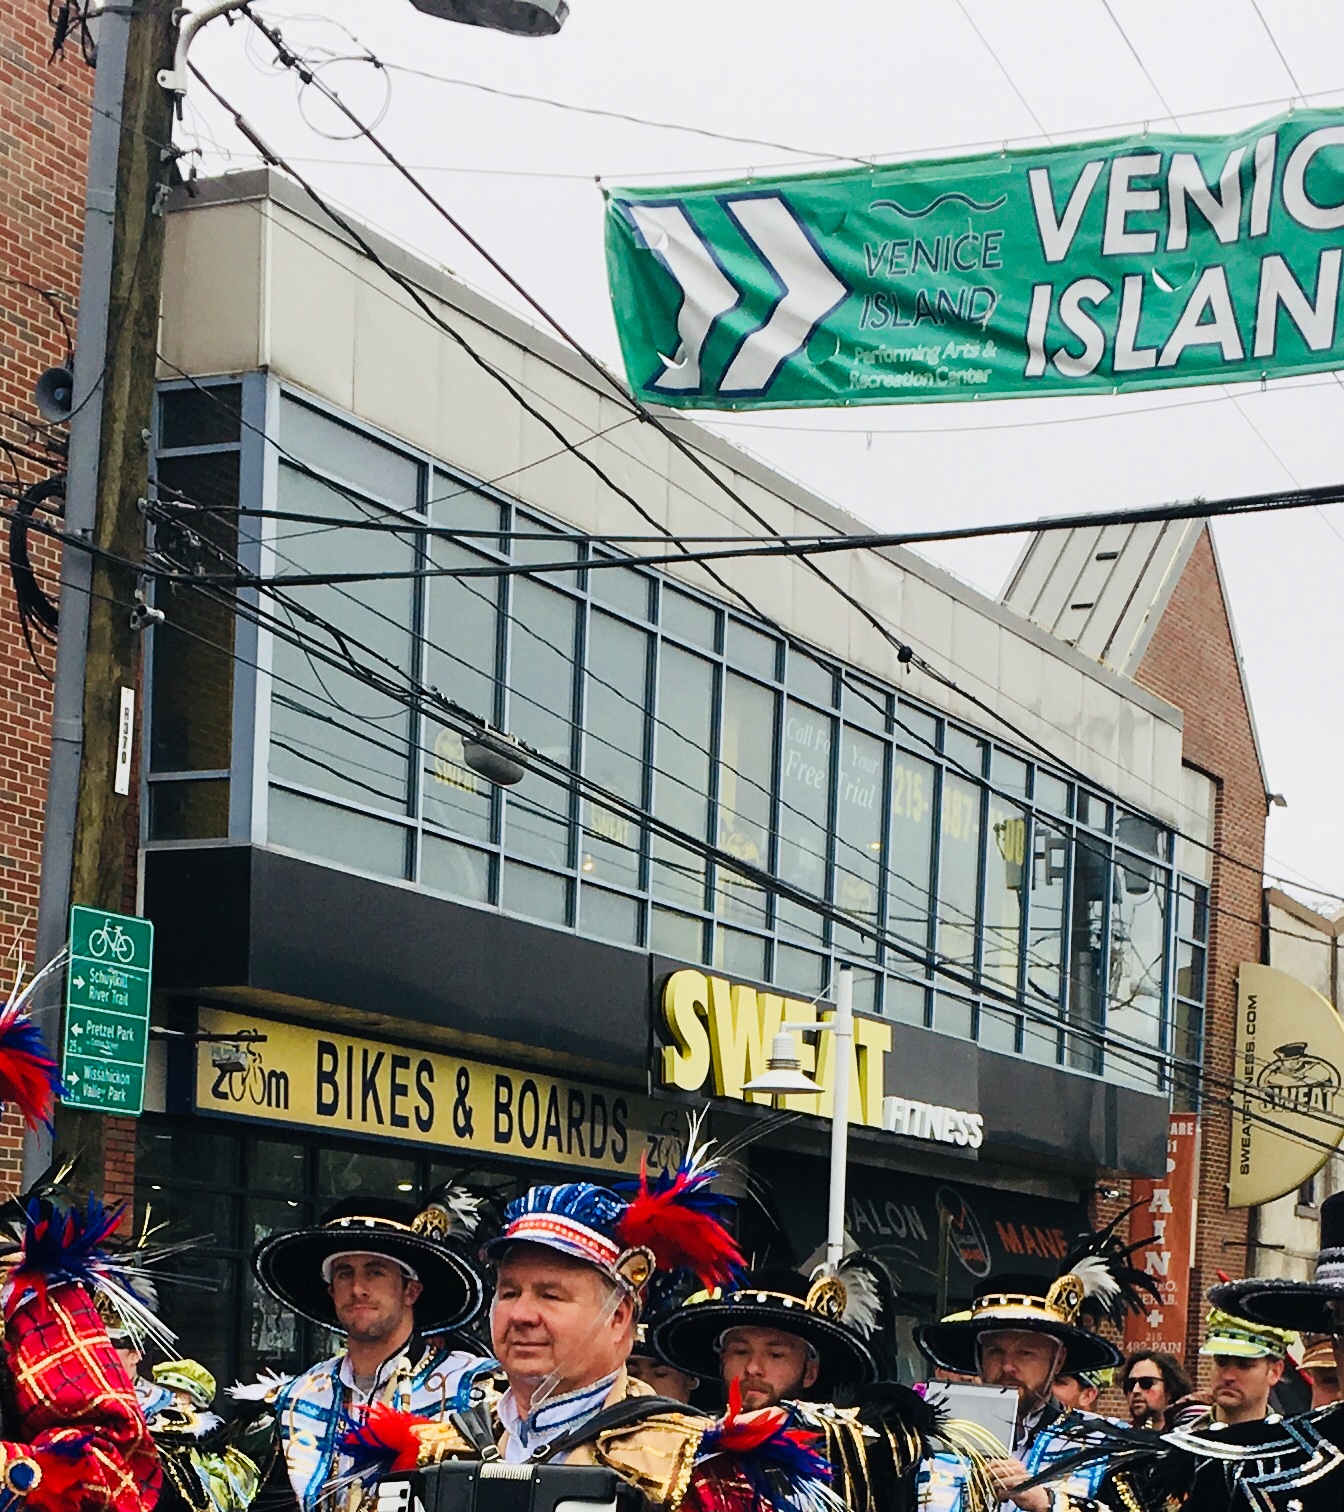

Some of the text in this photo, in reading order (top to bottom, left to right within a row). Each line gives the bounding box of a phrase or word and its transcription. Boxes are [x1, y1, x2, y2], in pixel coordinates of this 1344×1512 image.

[863, 230, 1005, 279] VENICE
[859, 286, 1000, 331] ISLAND
[854, 340, 998, 365] Performing Arts &
[850, 365, 993, 390] Recreation Center
[786, 717, 879, 776] Call Fo Your
[785, 749, 877, 809] Free Trial
[88, 985, 129, 1006] River Trail
[89, 967, 129, 989] Schuylkill
[86, 1020, 134, 1042] Pretzel Park
[660, 969, 892, 1129] SWEAT
[83, 1065, 130, 1085] Wissahickon
[83, 1083, 107, 1102] Valley
[108, 1085, 126, 1102] Park
[1240, 995, 1257, 1176] SWEATFITNESS.COM
[316, 1040, 435, 1132] BIKES
[455, 1066, 475, 1139] &
[494, 1074, 629, 1164] BOARDS
[647, 1136, 684, 1170] zoo
[1258, 1086, 1334, 1114] SWEAT
[883, 1096, 983, 1149] FITNESS
